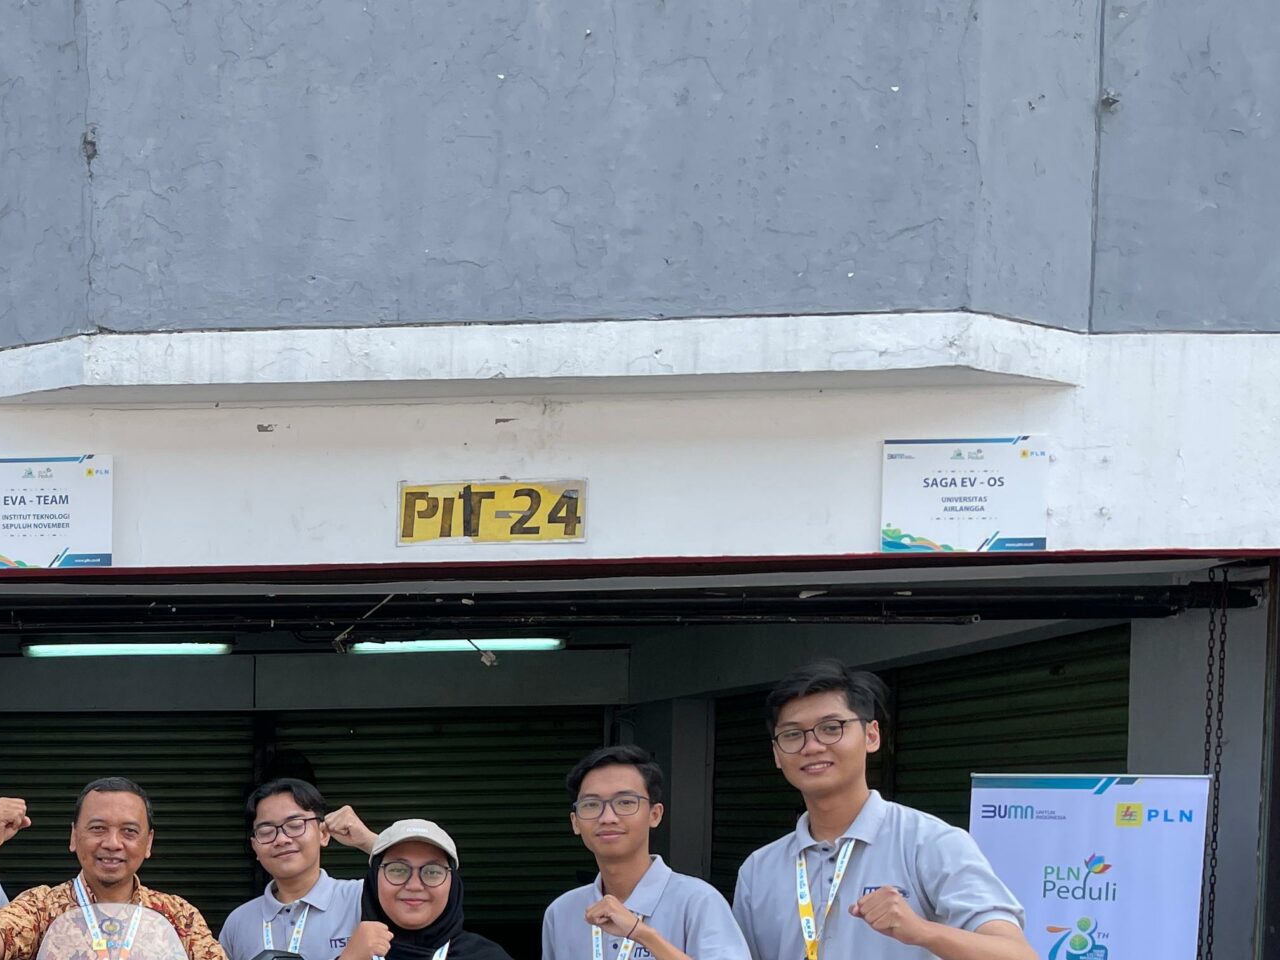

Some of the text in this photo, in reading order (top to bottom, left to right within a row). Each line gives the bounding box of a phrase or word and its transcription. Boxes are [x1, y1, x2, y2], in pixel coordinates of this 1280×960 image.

[923, 477, 957, 488] SAGA
[961, 477, 977, 488] EV
[987, 476, 1005, 487] OS
[3, 495, 26, 506] EVA
[36, 494, 69, 505] TEAM
[402, 485, 581, 538] PIT-24
[1147, 809, 1193, 823] PLN
[1044, 865, 1080, 881] PLN
[1042, 880, 1117, 901] Peduli
[329, 938, 346, 949] ITS
